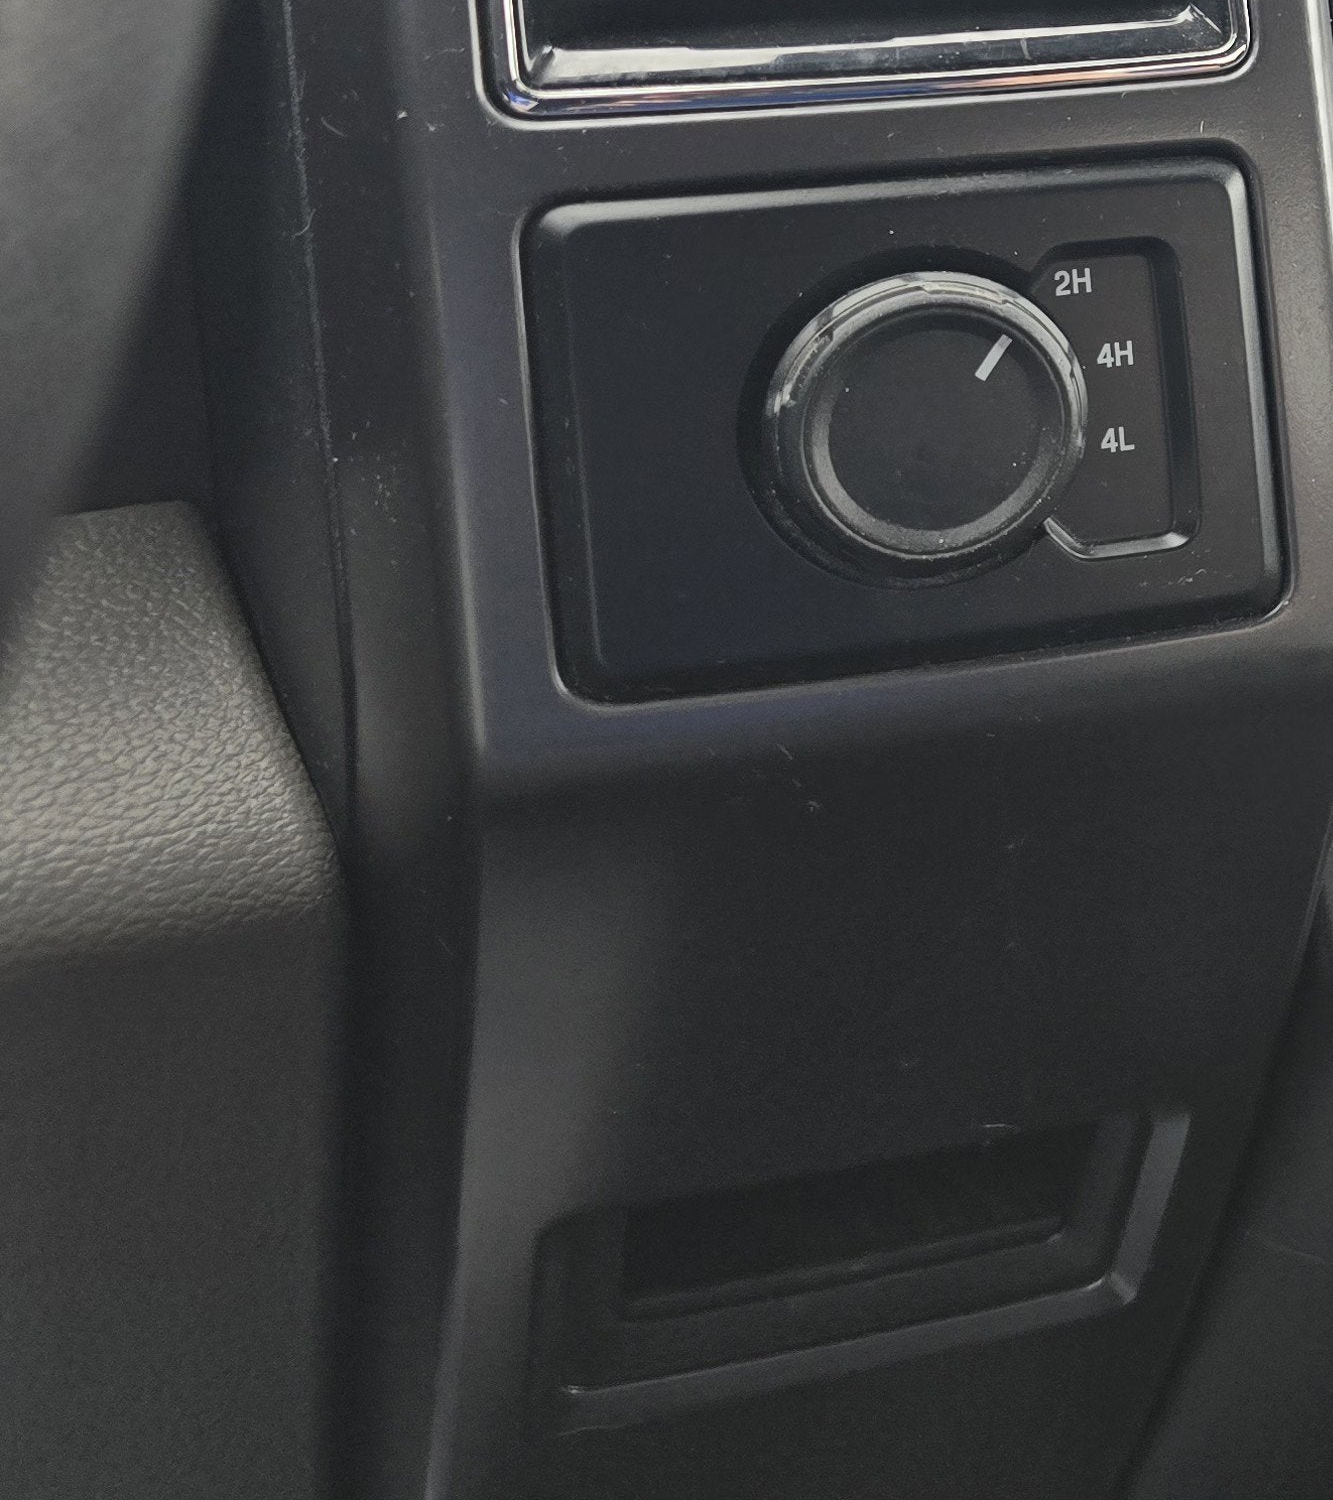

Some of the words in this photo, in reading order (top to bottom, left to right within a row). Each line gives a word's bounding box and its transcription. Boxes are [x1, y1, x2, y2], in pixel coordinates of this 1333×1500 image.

[1054, 267, 1092, 296] 2H
[1097, 340, 1134, 368] 4H
[1101, 427, 1135, 453] 4L
